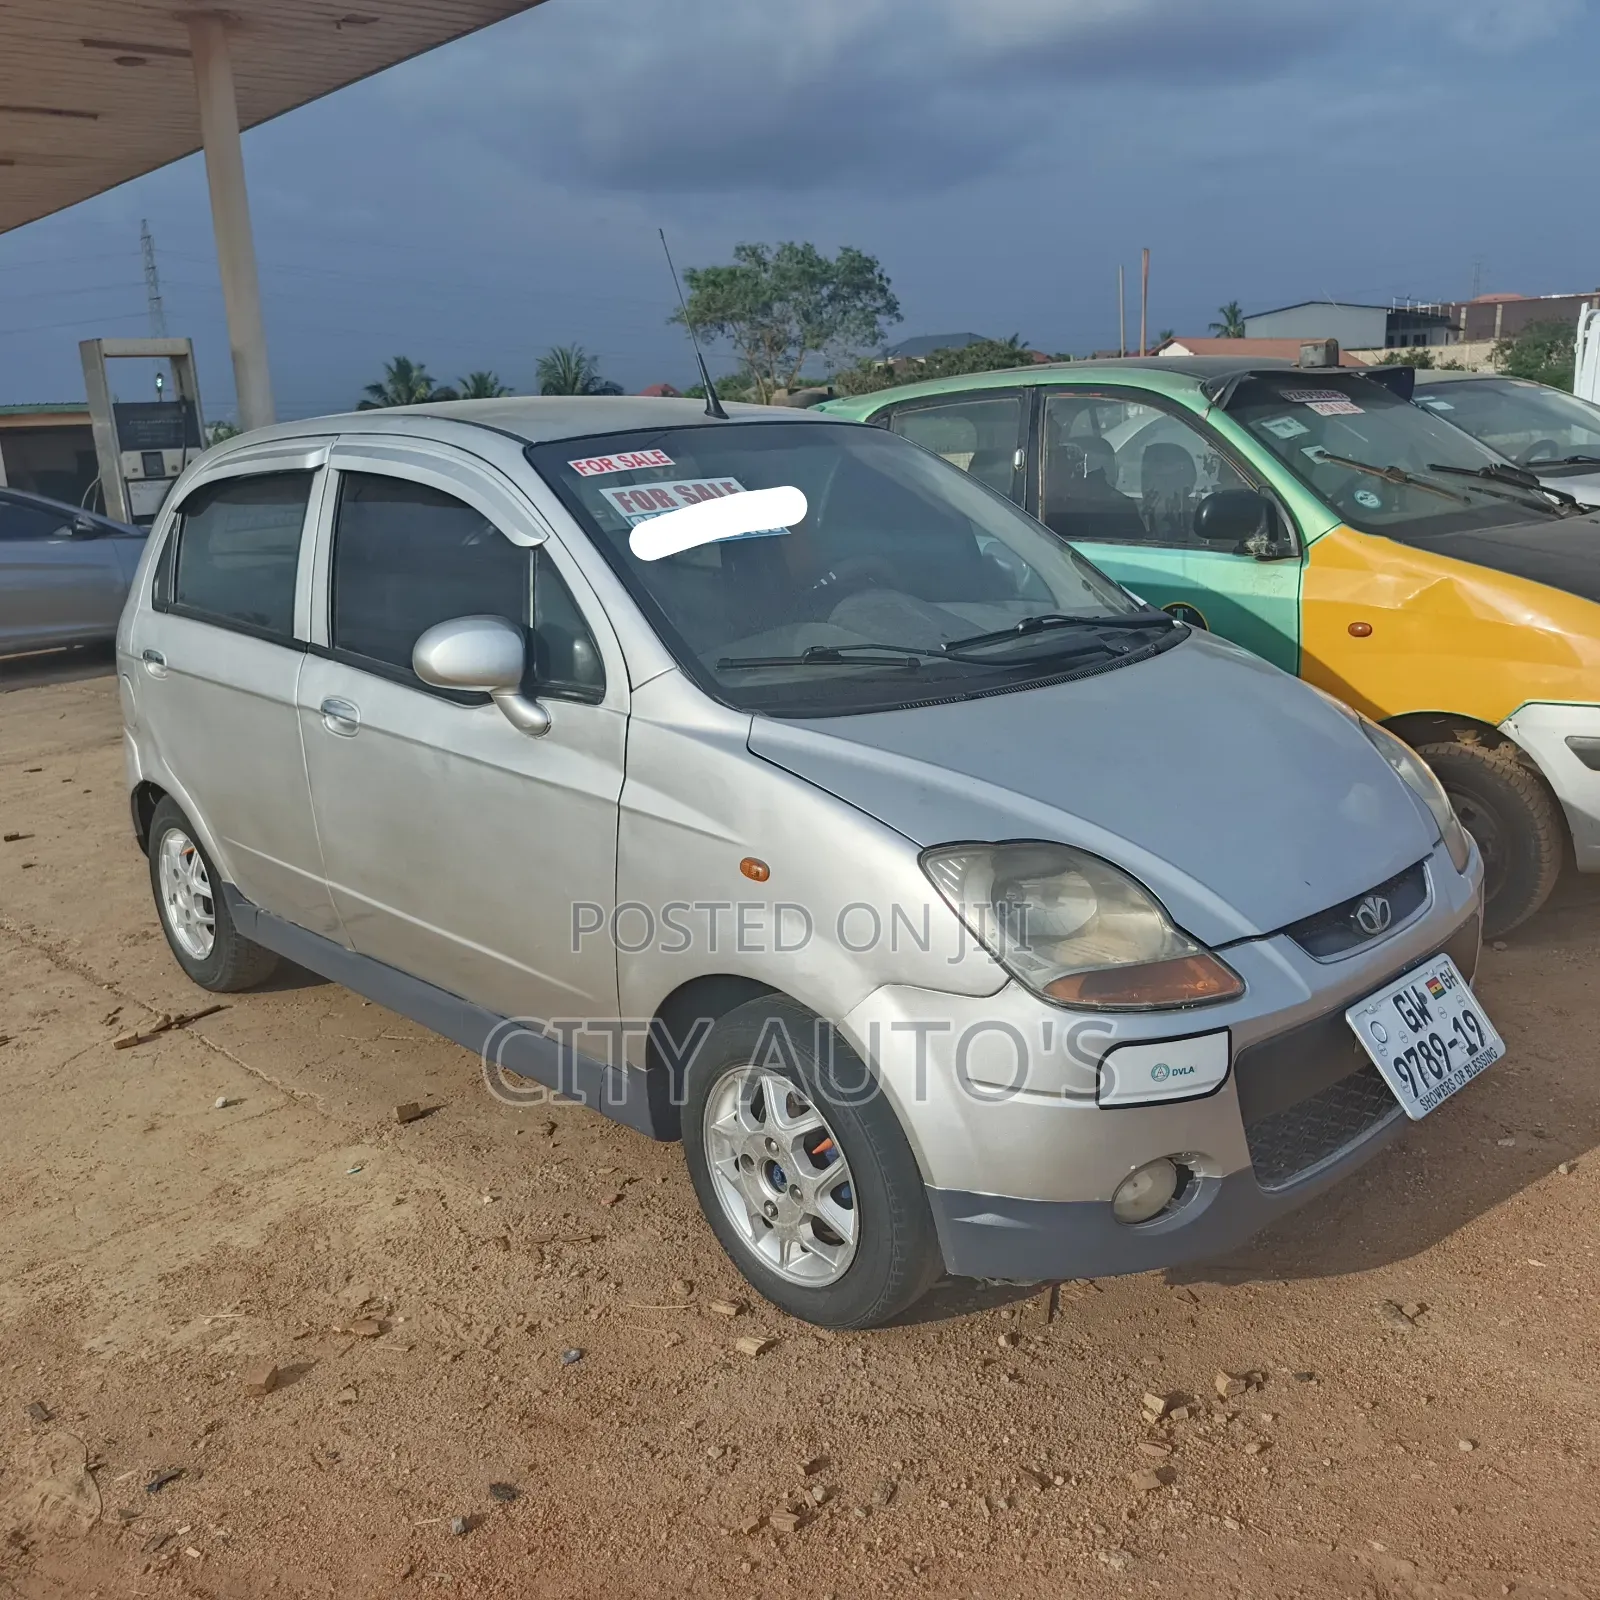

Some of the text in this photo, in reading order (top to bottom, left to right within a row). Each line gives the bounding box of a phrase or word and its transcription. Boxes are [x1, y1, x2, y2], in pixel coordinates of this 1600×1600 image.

[572, 450, 671, 475] FOR SALE
[612, 488, 672, 514] FOR
[1441, 967, 1459, 990] GH
[1391, 985, 1434, 1034] GW
[1393, 1009, 1486, 1098] 9789-19
[1172, 1066, 1195, 1077] DVLA
[1419, 1046, 1498, 1111] SHOWERS OF BLESSING
